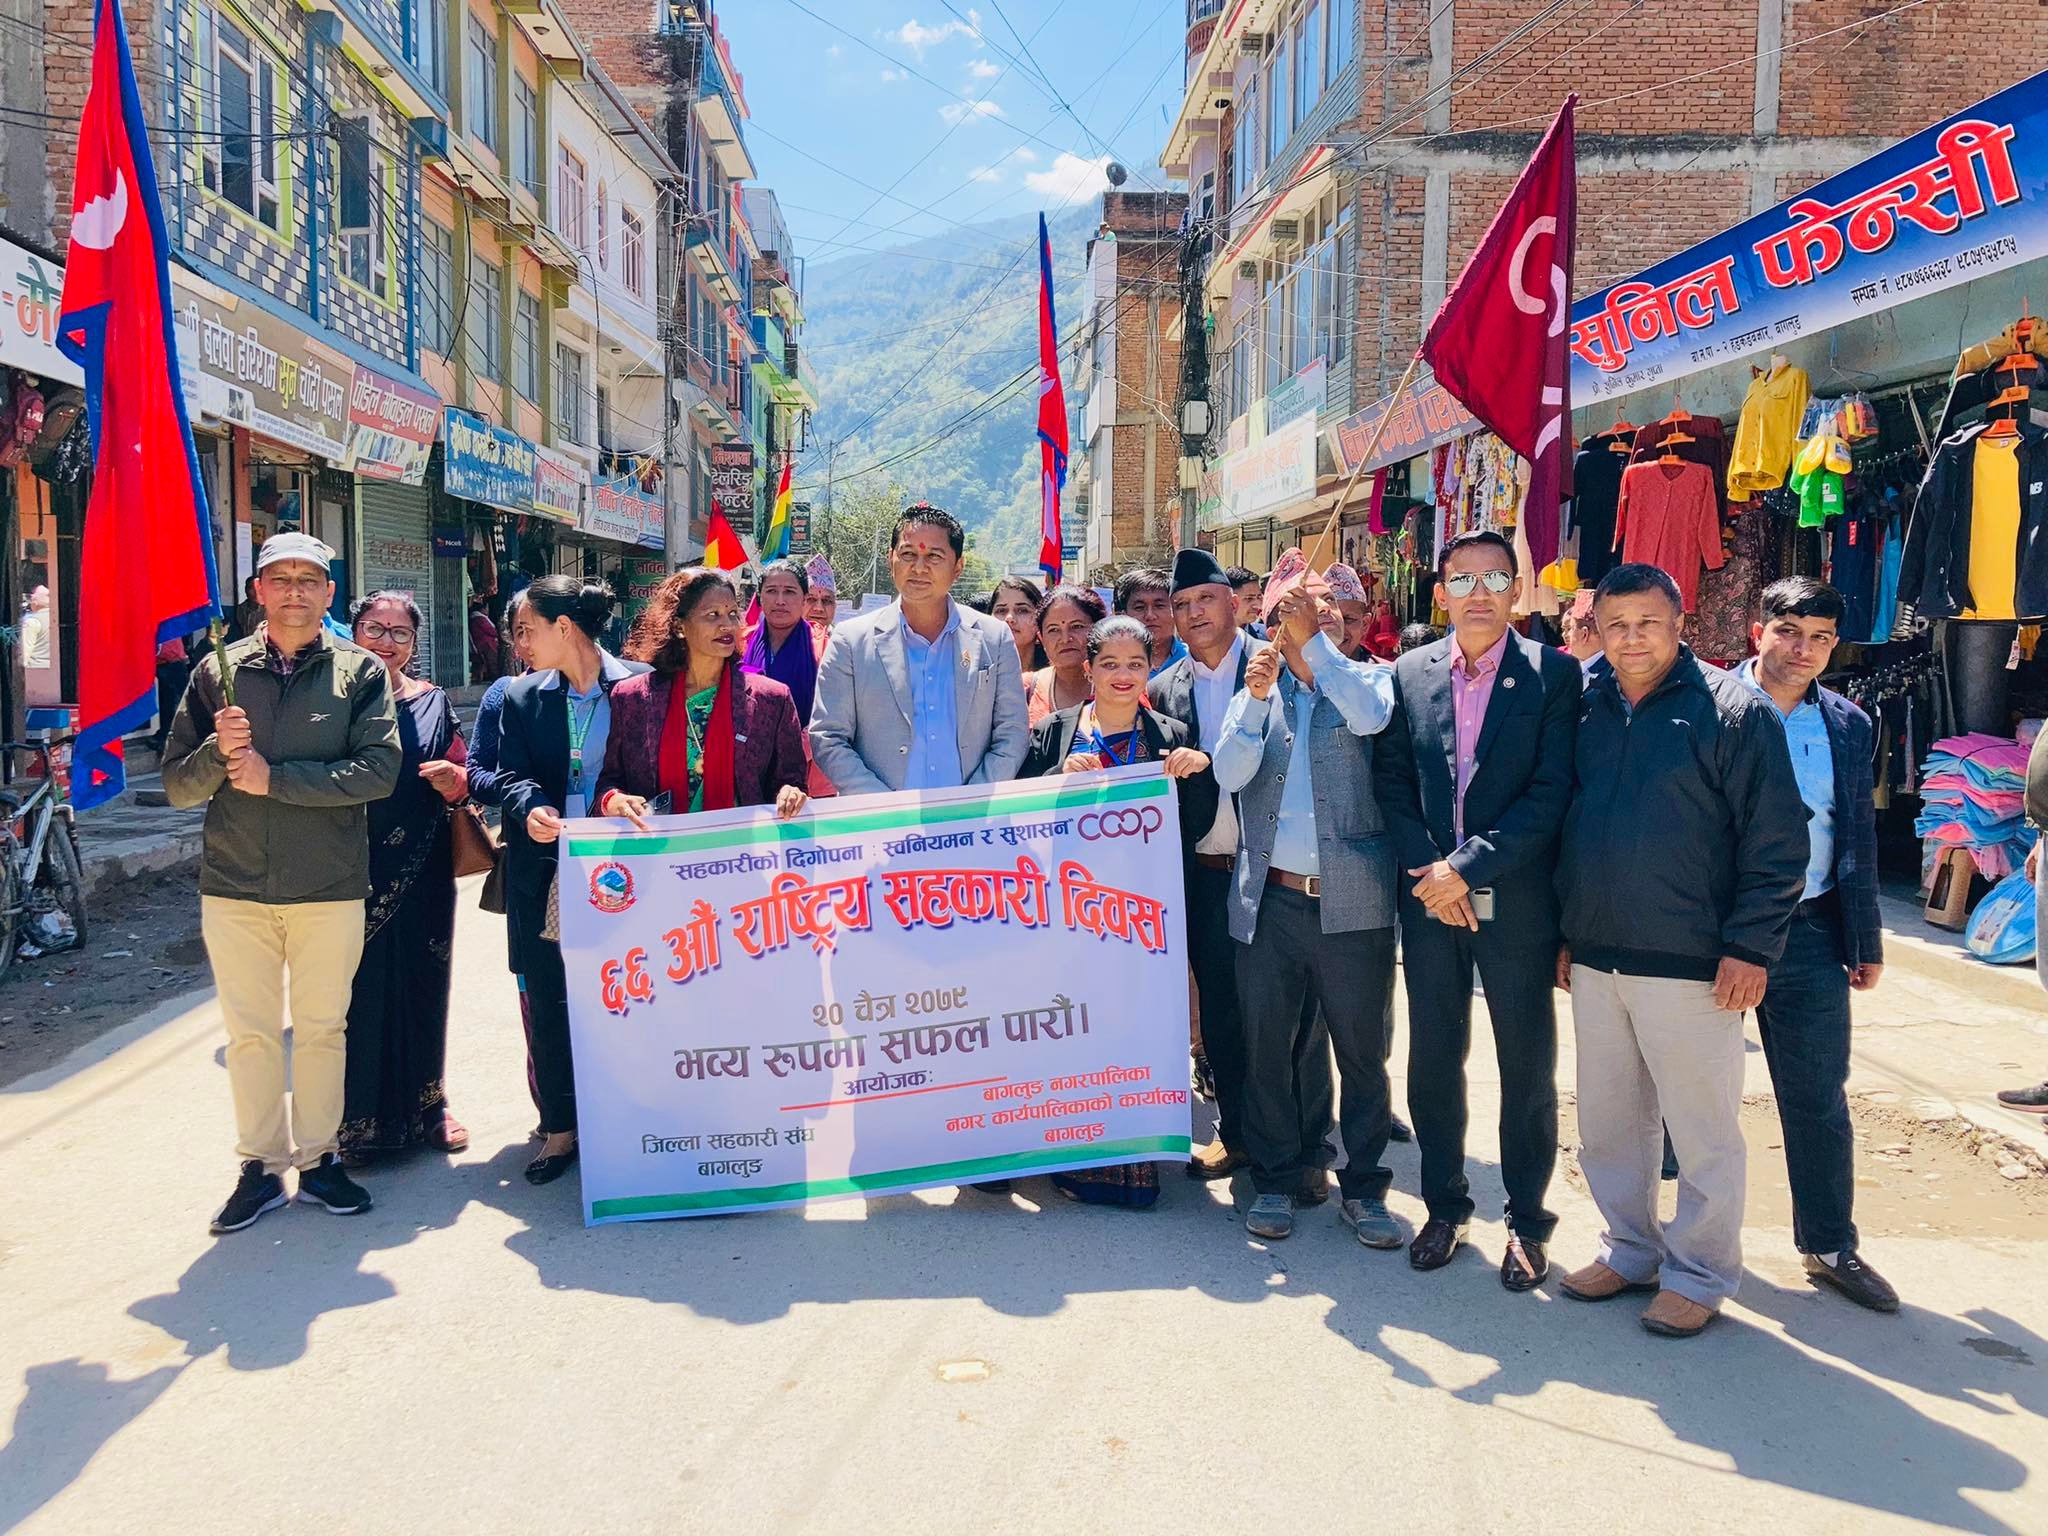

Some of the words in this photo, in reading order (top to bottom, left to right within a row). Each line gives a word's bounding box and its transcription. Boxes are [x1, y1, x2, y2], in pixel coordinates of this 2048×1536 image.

[1570, 255, 1742, 373] सुनिल
[1753, 119, 2021, 289] फेन्सी
[785, 845, 864, 870] दिगोपना
[882, 831, 975, 857] स्वनियमन
[980, 827, 995, 845] र
[600, 946, 654, 1015] ६६
[730, 871, 873, 956] राष्ट्रिय
[881, 855, 1050, 928] सहकारी
[1059, 859, 1167, 952] दिवस
[811, 1002, 844, 1027] २०
[853, 989, 897, 1022] चैत्र
[905, 985, 969, 1015] २०७९
[674, 1046, 751, 1080] भव्य
[878, 1016, 991, 1064] सफल
[983, 1080, 1045, 1102] बागलुङ
[1049, 1065, 1151, 1093] नगरपालिका
[946, 1112, 986, 1133] नगर
[991, 1091, 1113, 1126] कार्यपालिकाको
[1118, 1087, 1187, 1109] कार्यालय
[642, 1133, 702, 1154] जिल्ला
[707, 1127, 779, 1150] सहकारी
[784, 1126, 816, 1145] संघ
[1044, 1122, 1106, 1143] बागलुङ
[697, 1158, 764, 1178] बागलुङ
